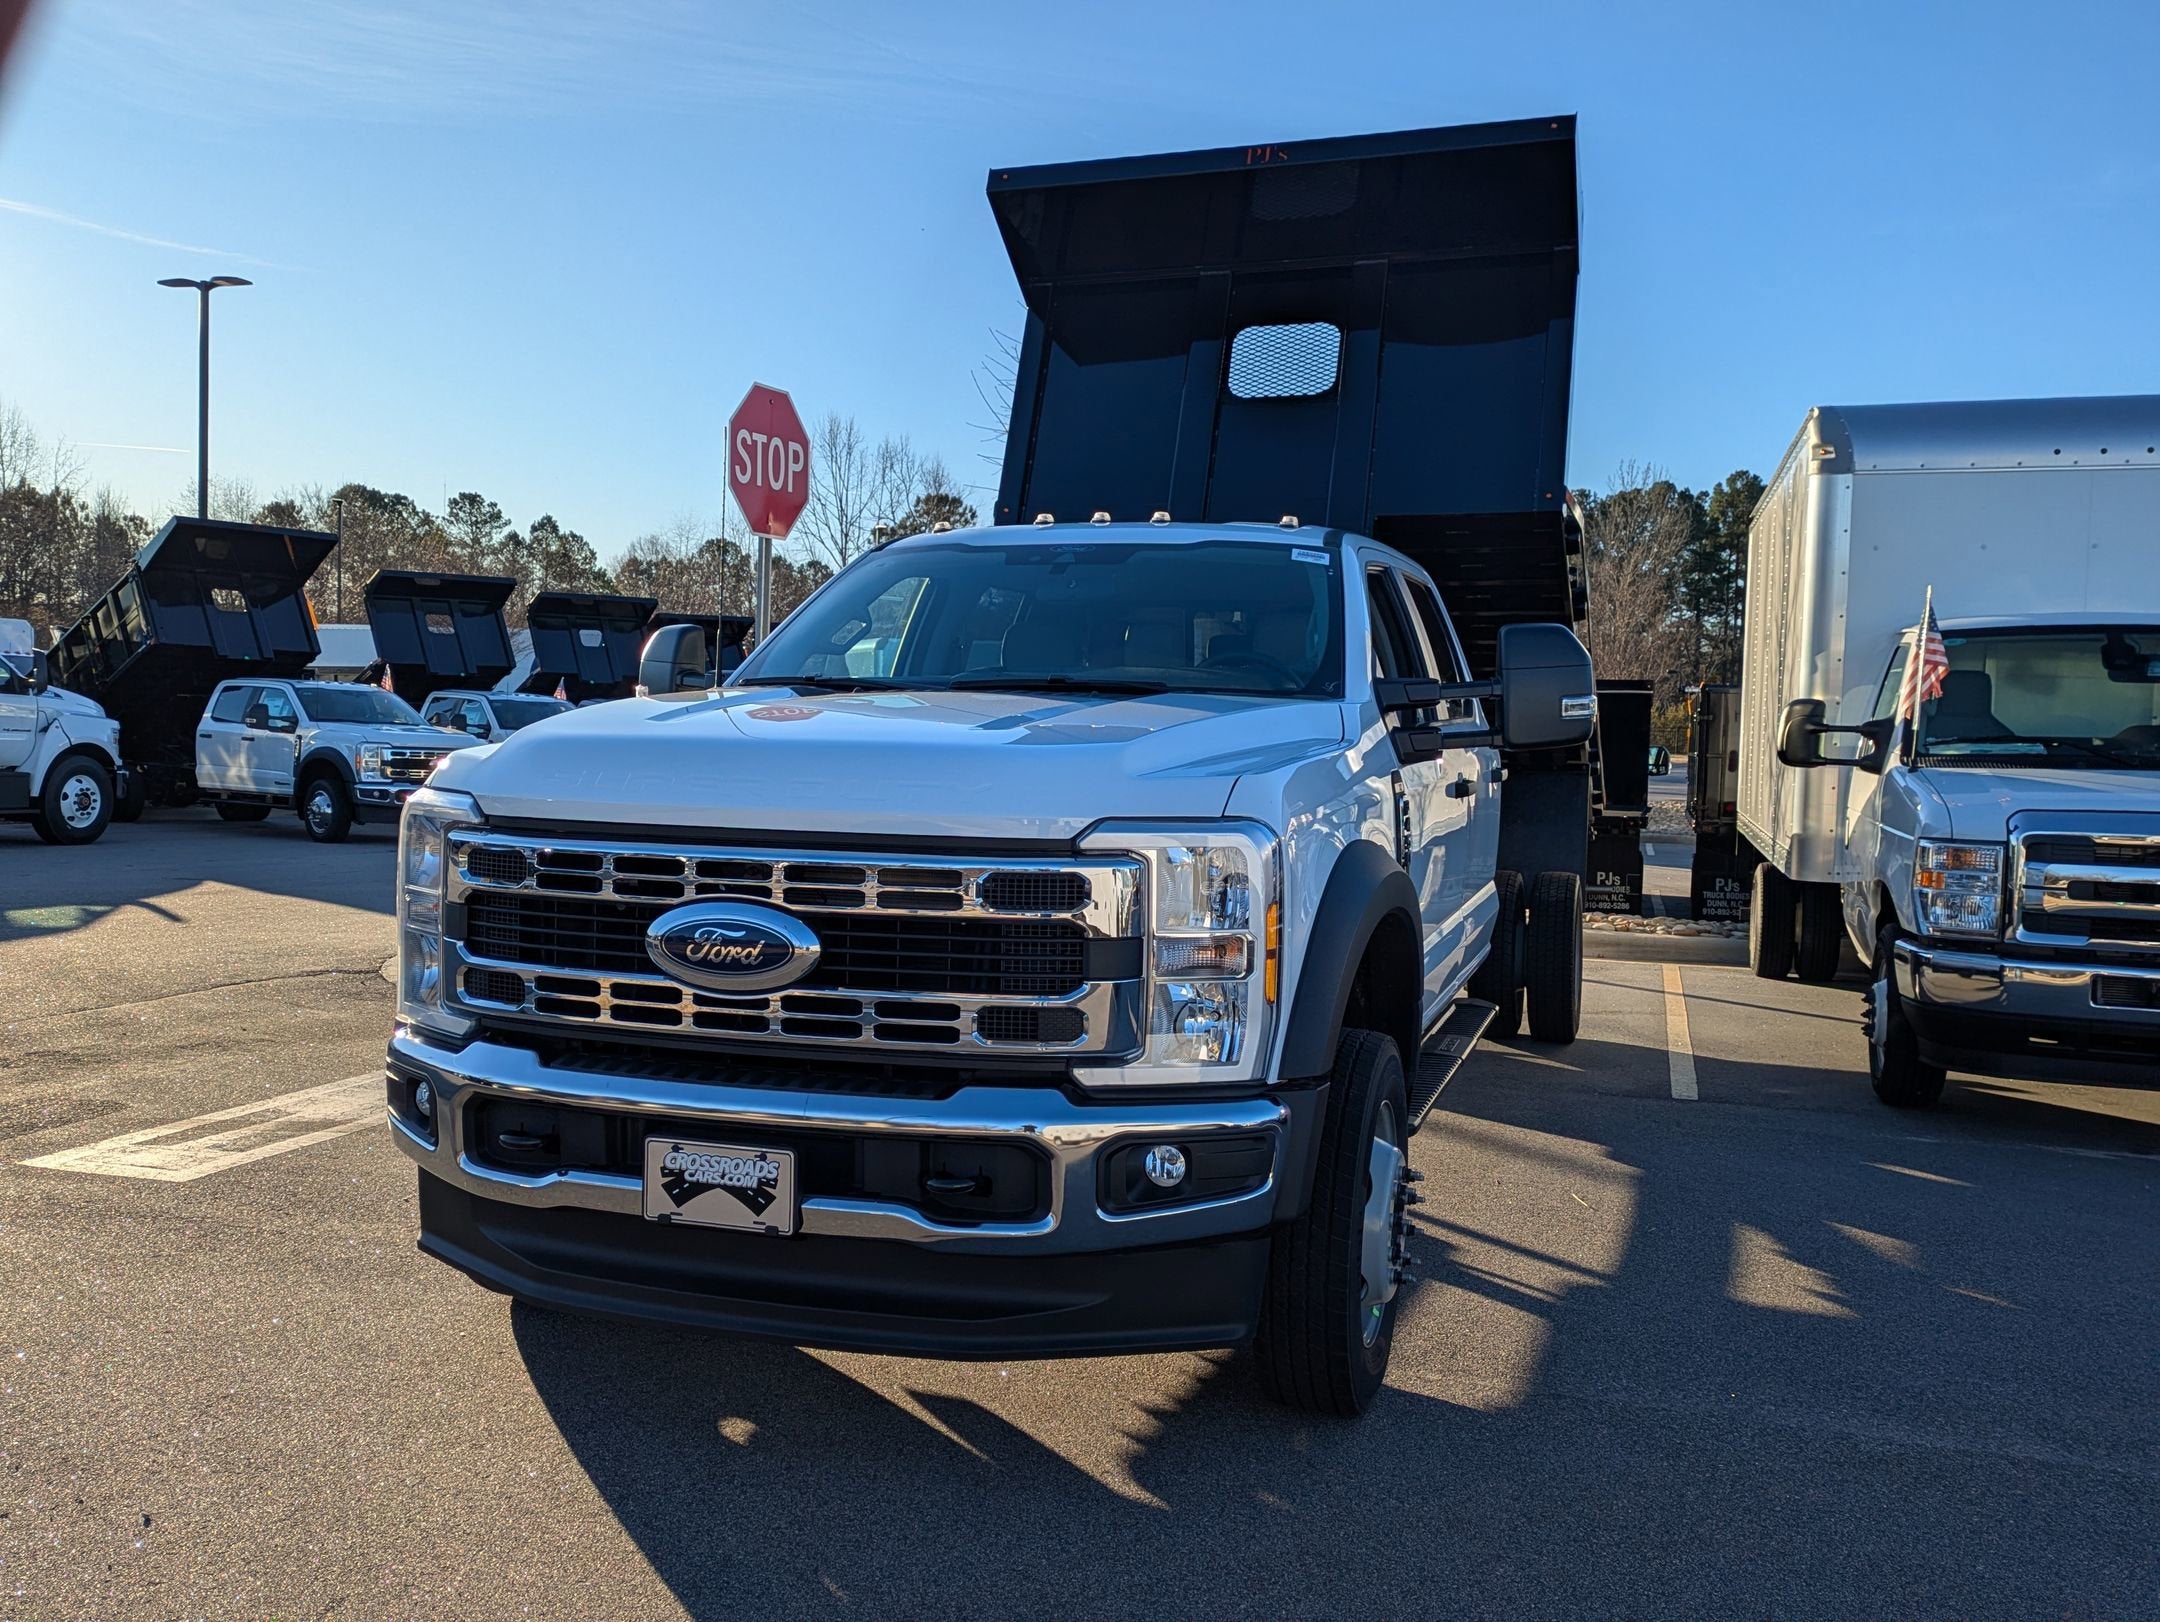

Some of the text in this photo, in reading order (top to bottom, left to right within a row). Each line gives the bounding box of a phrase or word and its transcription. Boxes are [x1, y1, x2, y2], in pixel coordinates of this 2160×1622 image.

[735, 429, 804, 493] STOP
[1703, 891, 1725, 899] TRUCK
[686, 927, 766, 966] Ford
[664, 1151, 780, 1180] CROSSROADS
[683, 1169, 759, 1189] CARS.COM
